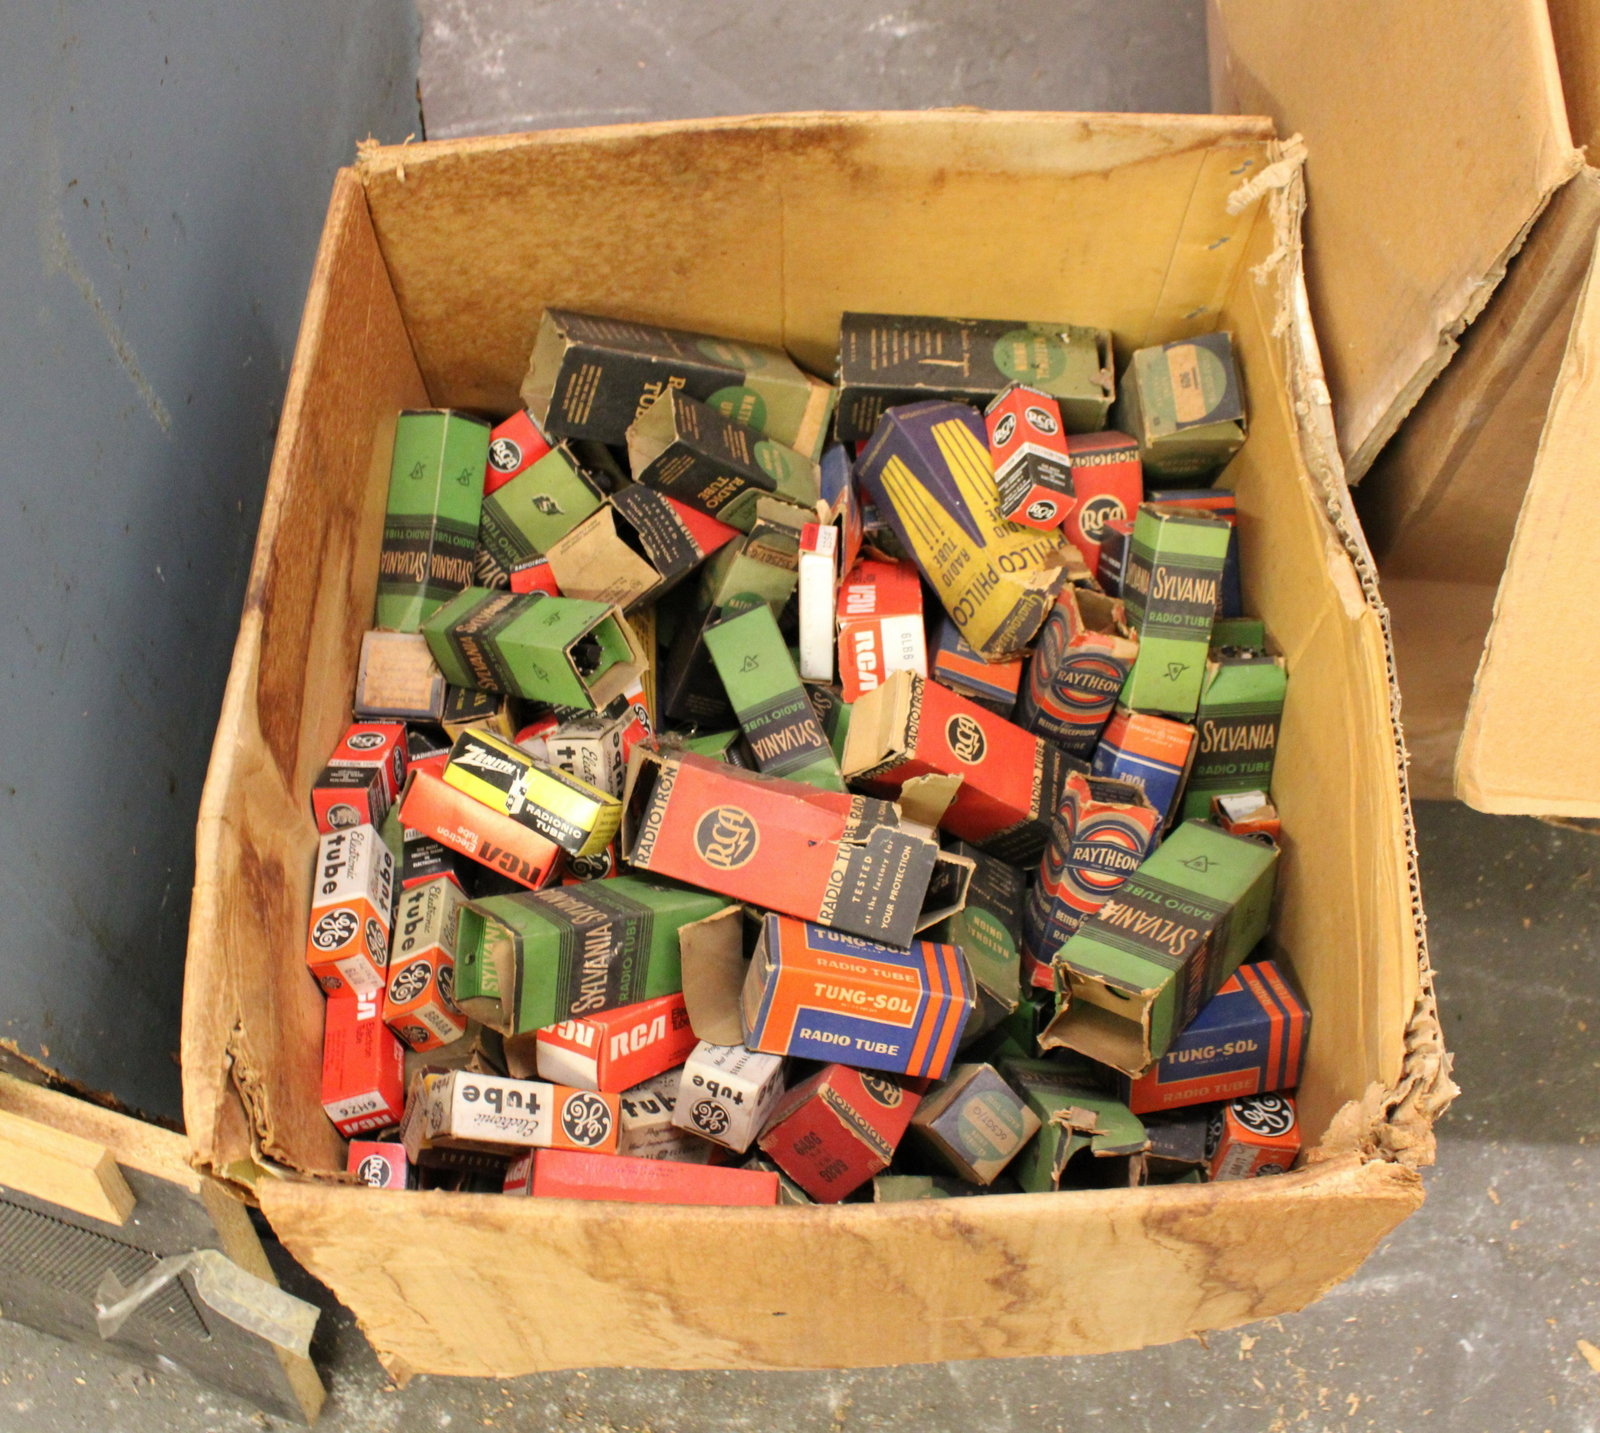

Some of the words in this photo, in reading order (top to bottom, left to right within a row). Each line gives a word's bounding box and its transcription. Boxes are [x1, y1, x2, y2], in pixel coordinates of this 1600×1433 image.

[994, 416, 1015, 444] RCA
[1027, 411, 1057, 431] RCA
[492, 440, 519, 471] RCA
[1070, 452, 1139, 468] ADIOTRON
[697, 476, 730, 499] TUBE
[706, 477, 745, 508] RADIO
[1028, 503, 1056, 519] RCA
[1082, 506, 1122, 533] RCA
[381, 552, 427, 582] SYLVANIA
[932, 537, 958, 569] TUBE
[941, 548, 971, 588] RADIO
[431, 553, 473, 590] SYLVANIA
[1152, 566, 1217, 606] SYLVANIA
[846, 584, 877, 614] RCA
[952, 563, 1000, 627] PHILCO
[1149, 611, 1182, 625] RADIO
[1184, 615, 1212, 628] TUBE
[854, 630, 879, 691] RCA
[1056, 670, 1121, 693] RAYTHEON
[744, 717, 772, 734] TUBE
[771, 701, 806, 721] RADIO
[908, 677, 925, 751] RADIOTRON
[351, 735, 383, 748] RCA
[751, 719, 823, 762] SYLVANIA
[954, 716, 977, 762] RCA
[1200, 719, 1276, 754] SYLVANIA
[451, 743, 518, 774] ZENITH
[1239, 761, 1271, 774] TUBE
[1031, 775, 1042, 815] RADIO
[1119, 772, 1147, 787] TUBE
[535, 818, 567, 842] TUBE
[637, 766, 678, 865] RADIOTRON
[437, 825, 477, 853] Electron
[457, 825, 479, 843] Tube
[704, 807, 749, 868] RCA
[322, 833, 347, 896] tube
[346, 830, 365, 881] Electronic
[479, 840, 542, 885] RCA
[1072, 846, 1141, 873] RAYTHEON
[378, 852, 393, 914] tube
[851, 855, 874, 904] TESTED
[868, 894, 878, 912] the
[873, 858, 890, 892] factory
[883, 840, 894, 854] for
[880, 903, 896, 930] YOUR
[889, 844, 913, 902] PROTECTION
[424, 885, 442, 934] Electronic
[533, 888, 609, 926] SYLVANIA
[819, 869, 845, 921] RADIO
[1122, 884, 1164, 905] TUBE
[1164, 899, 1216, 921] RADIO
[401, 890, 425, 952] tube
[623, 918, 638, 954] TUBE
[973, 916, 1003, 940] UNION
[1097, 899, 1199, 956] SYLVANIA
[570, 922, 614, 1014] SYLVANIA
[618, 957, 634, 1003] RADIO
[816, 957, 868, 974] RADIO
[869, 967, 916, 984] TUBE
[813, 982, 913, 1014] TUNG-SOL
[609, 1014, 667, 1063] RCA
[799, 1027, 852, 1047] RADIO
[854, 1037, 900, 1057] TUBE
[1165, 1039, 1259, 1065] TUNG-SOL
[462, 1084, 541, 1116] tube
[691, 1074, 745, 1106] tube
[1162, 1087, 1212, 1104] RADIO
[1213, 1079, 1255, 1094] TUBE
[339, 1100, 378, 1119] 6HZ6
[342, 1113, 393, 1134] RCA
[474, 1112, 540, 1138] Electronic
[826, 1086, 893, 1157] RADIOTRON
